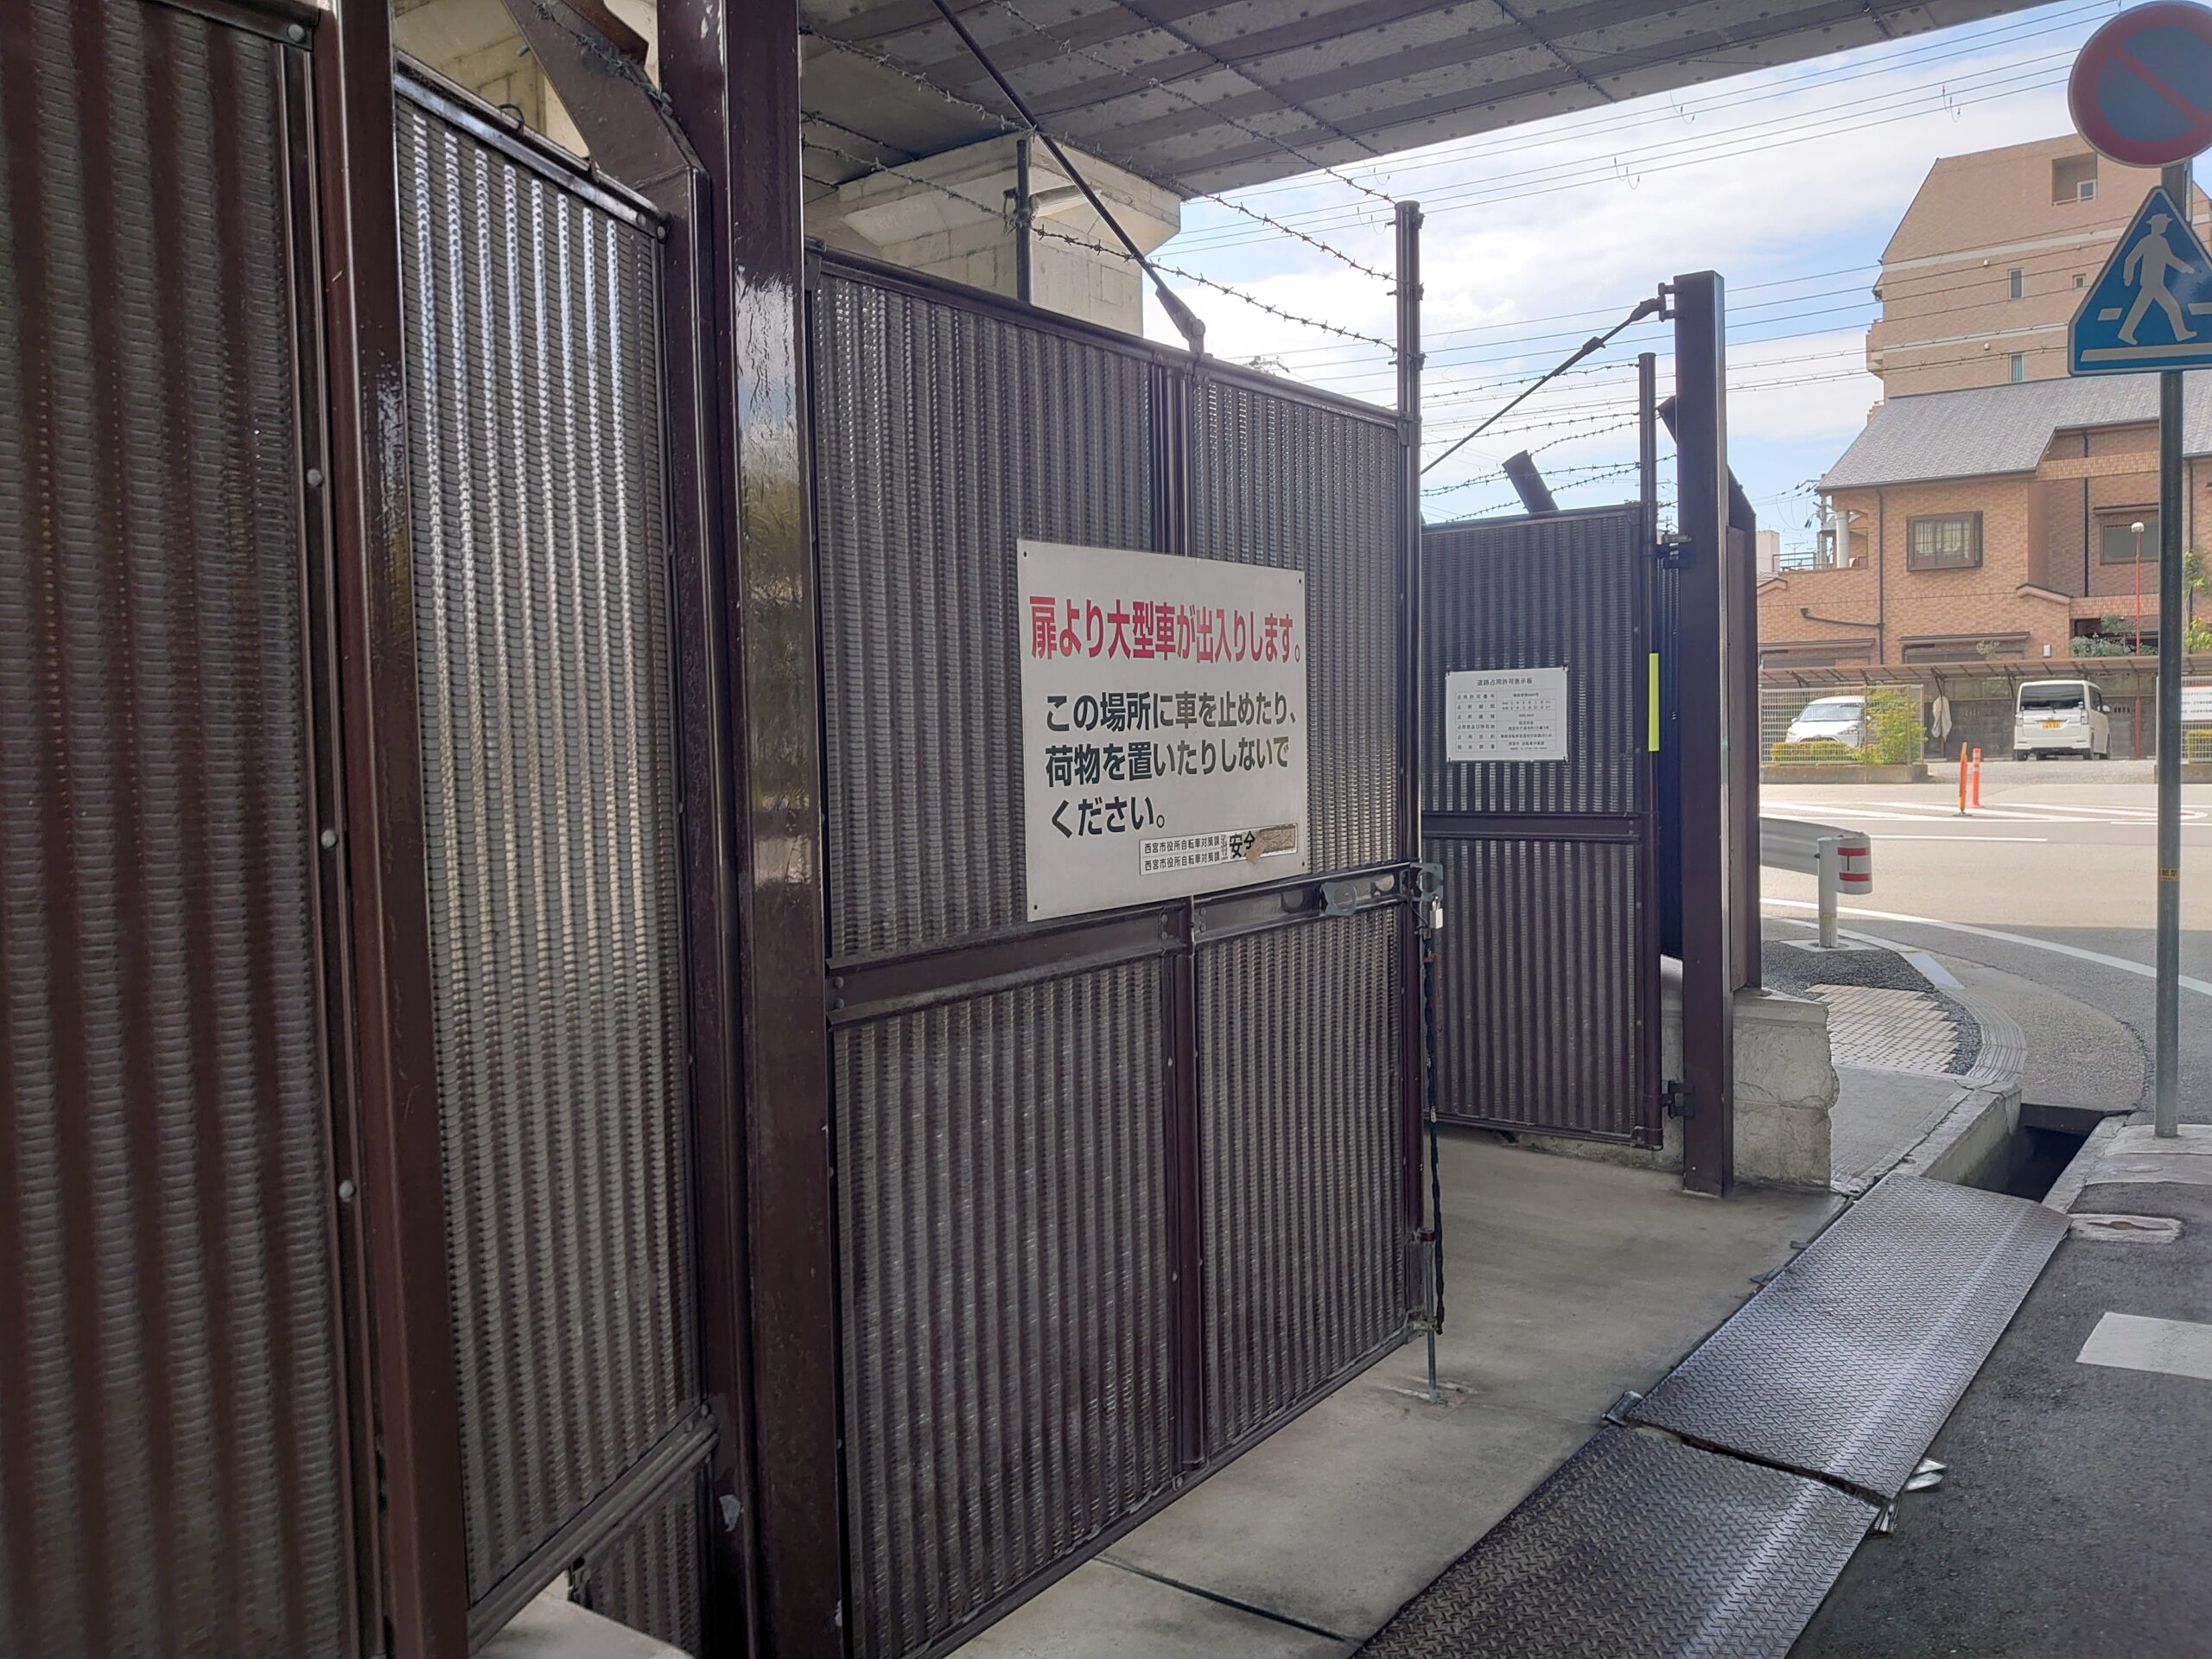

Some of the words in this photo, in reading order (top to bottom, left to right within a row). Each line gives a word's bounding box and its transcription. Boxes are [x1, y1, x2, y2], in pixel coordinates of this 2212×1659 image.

[1029, 596, 1300, 663] 扉より大型車が出入りします。
[1046, 691, 1296, 732] この場所に車を止めたり、
[1046, 736, 1289, 787] 荷物を置いたりしないで
[1051, 797, 1165, 838] ください。
[1145, 836, 1220, 854] 西宮市役所自転車対策課
[1145, 851, 1220, 871] 西宮市役所自転車対策課
